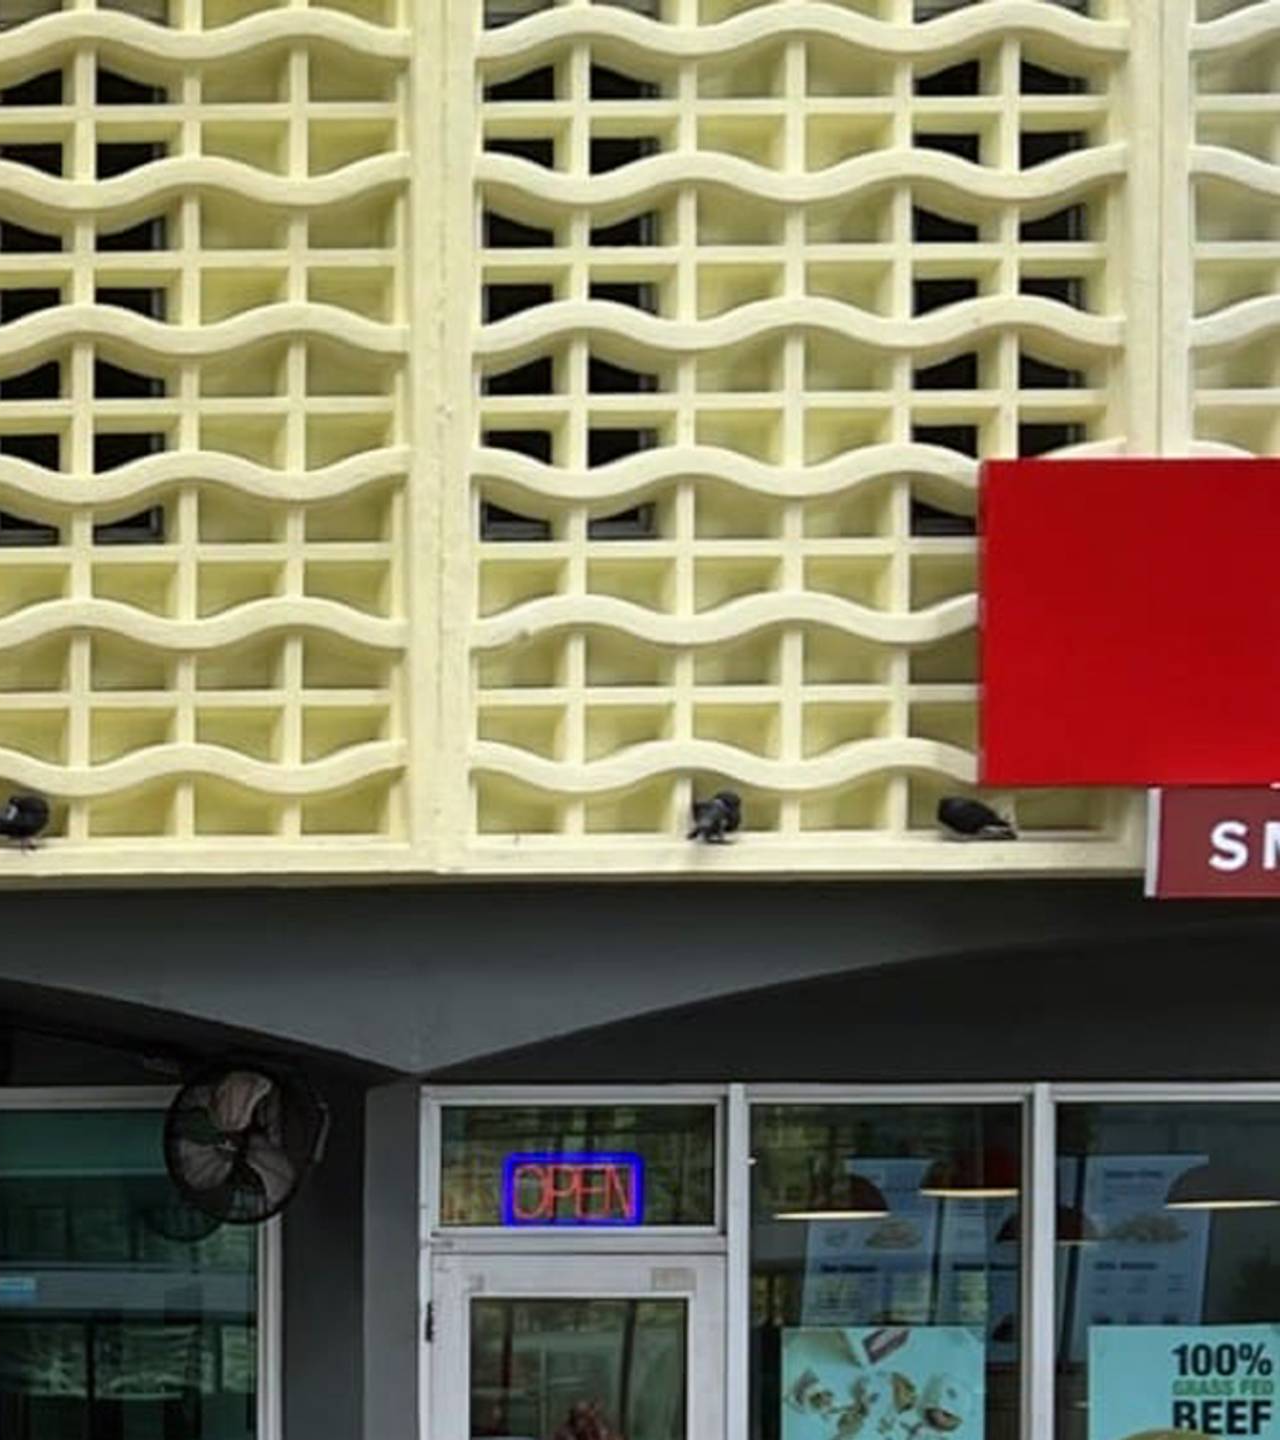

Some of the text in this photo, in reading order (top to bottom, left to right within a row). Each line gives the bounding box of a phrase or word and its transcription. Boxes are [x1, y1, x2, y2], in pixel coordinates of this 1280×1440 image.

[512, 1163, 637, 1220] OPEN
[1171, 1342, 1273, 1376] 100%
[1171, 1379, 1275, 1396] GRASS FED
[1172, 1399, 1273, 1436] BEEF
